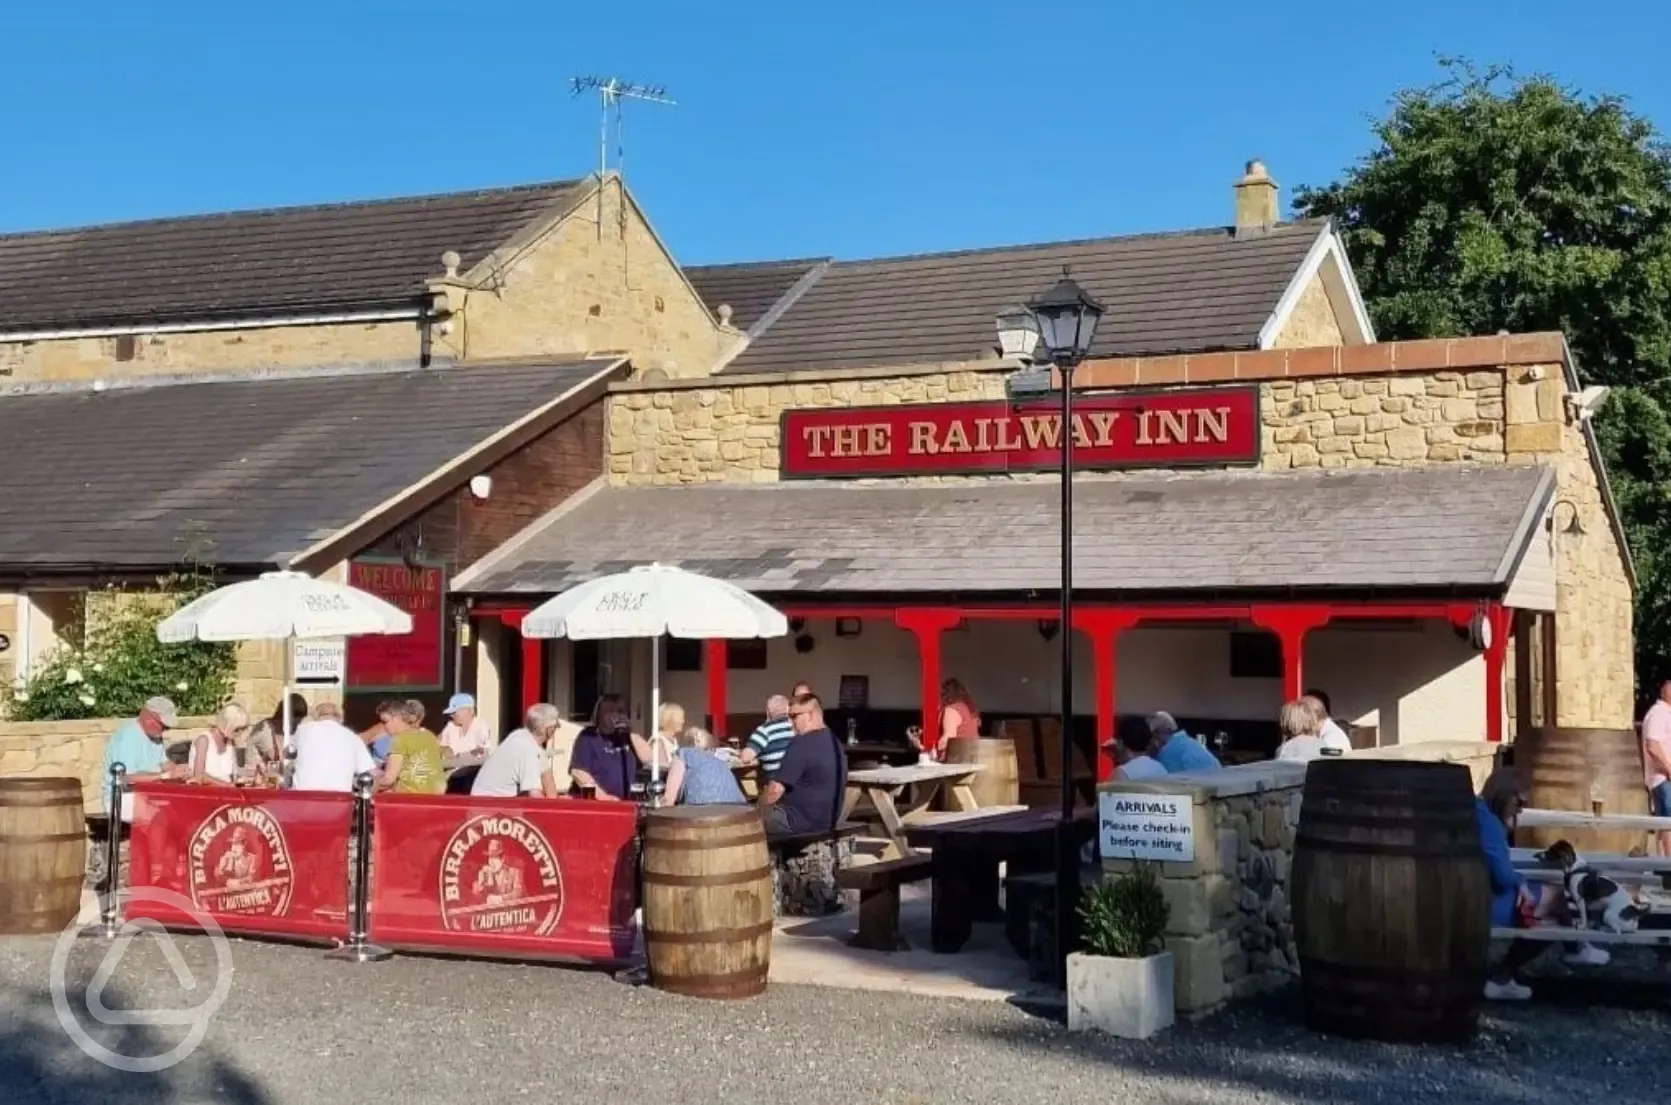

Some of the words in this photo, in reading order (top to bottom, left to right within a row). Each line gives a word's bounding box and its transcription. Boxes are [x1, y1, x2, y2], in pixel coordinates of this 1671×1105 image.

[803, 422, 892, 458] THE
[908, 412, 1120, 454] RAILWAY
[1135, 406, 1231, 445] INN
[357, 565, 436, 591] WELCOME
[1115, 801, 1177, 814] ARRIVALS
[1102, 819, 1140, 832] Please
[192, 816, 228, 884] BIRRA
[227, 807, 289, 873] MORETTI
[1110, 835, 1148, 848] before
[445, 827, 482, 901] BIRRA
[481, 818, 558, 888] MORETTI
[471, 907, 536, 931] L'AUTENTICA
